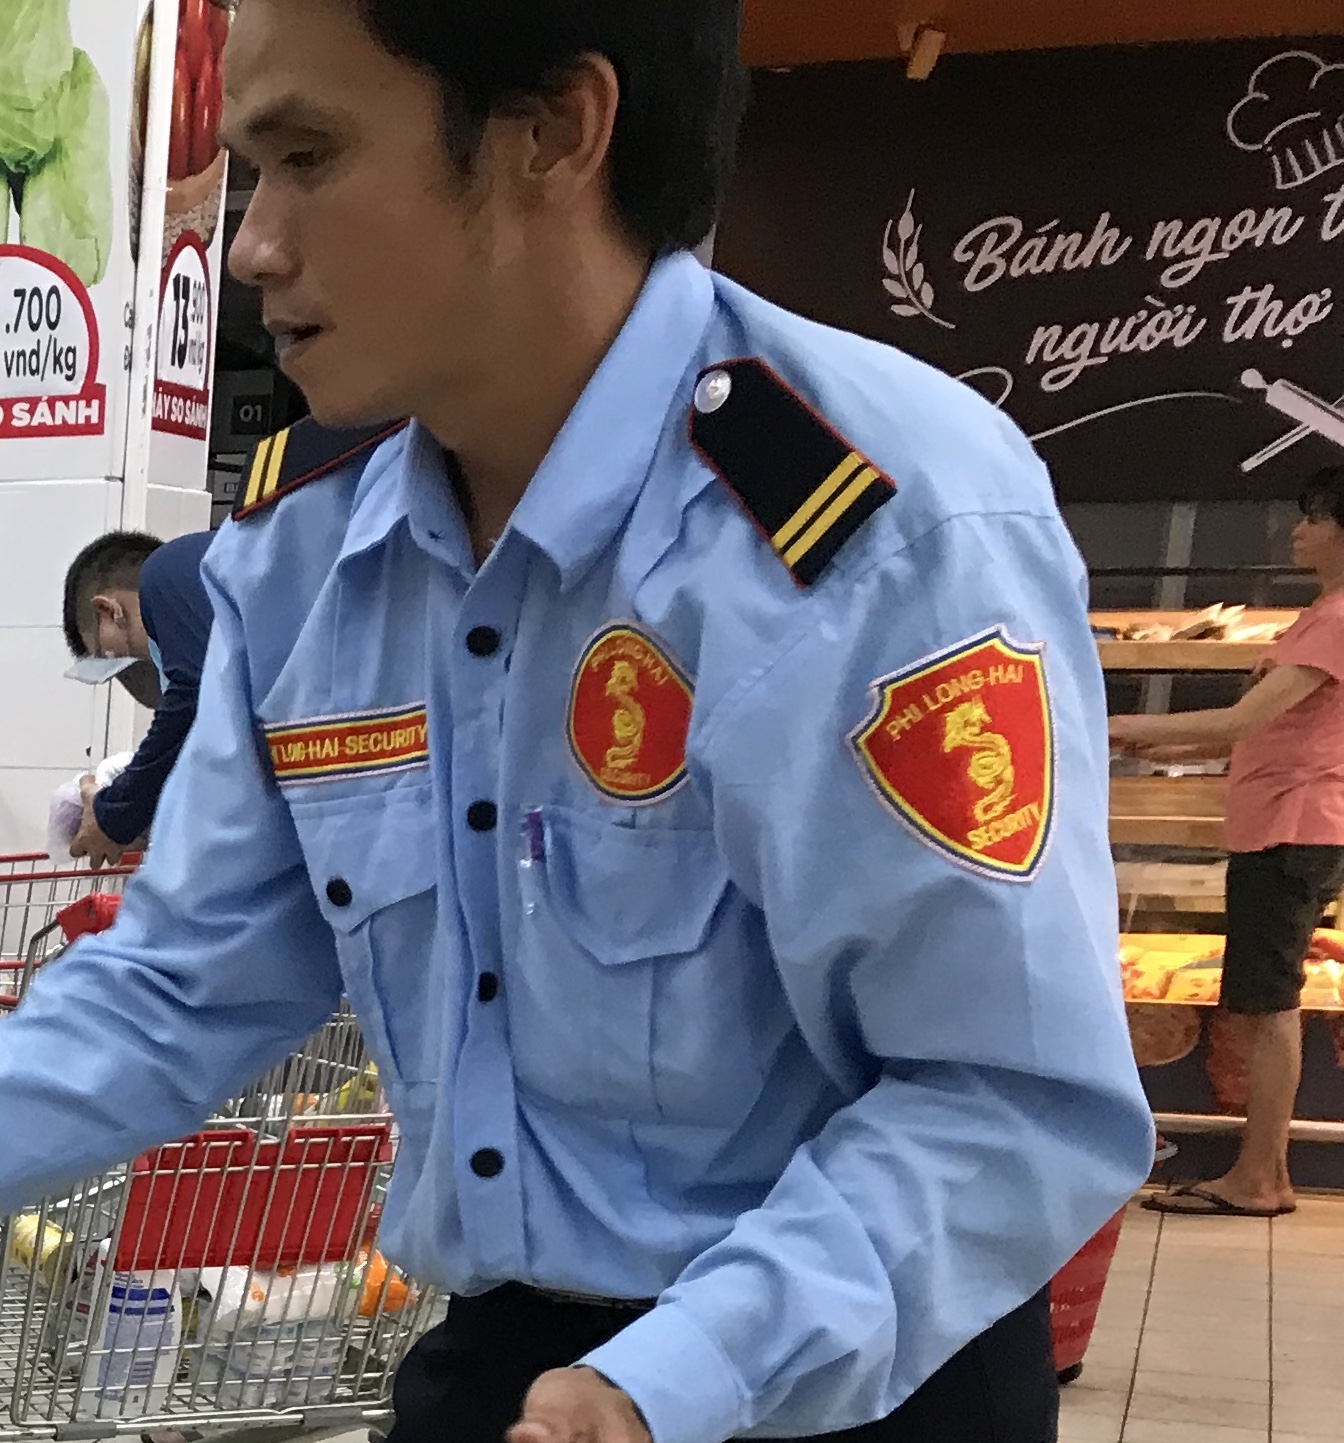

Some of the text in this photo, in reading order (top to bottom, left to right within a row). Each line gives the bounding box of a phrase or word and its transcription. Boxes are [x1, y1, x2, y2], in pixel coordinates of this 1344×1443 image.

[954, 211, 1133, 292] Bánh
[1145, 201, 1305, 289] ngon
[5, 285, 62, 334] .700
[171, 272, 190, 369] 13
[4, 335, 77, 382] vnd/kg
[1024, 284, 1332, 393] người thợ
[11, 395, 99, 427] SÁNH
[239, 405, 263, 423] 01
[345, 724, 428, 756] SECURITY
[967, 801, 1041, 850] SECURITY
